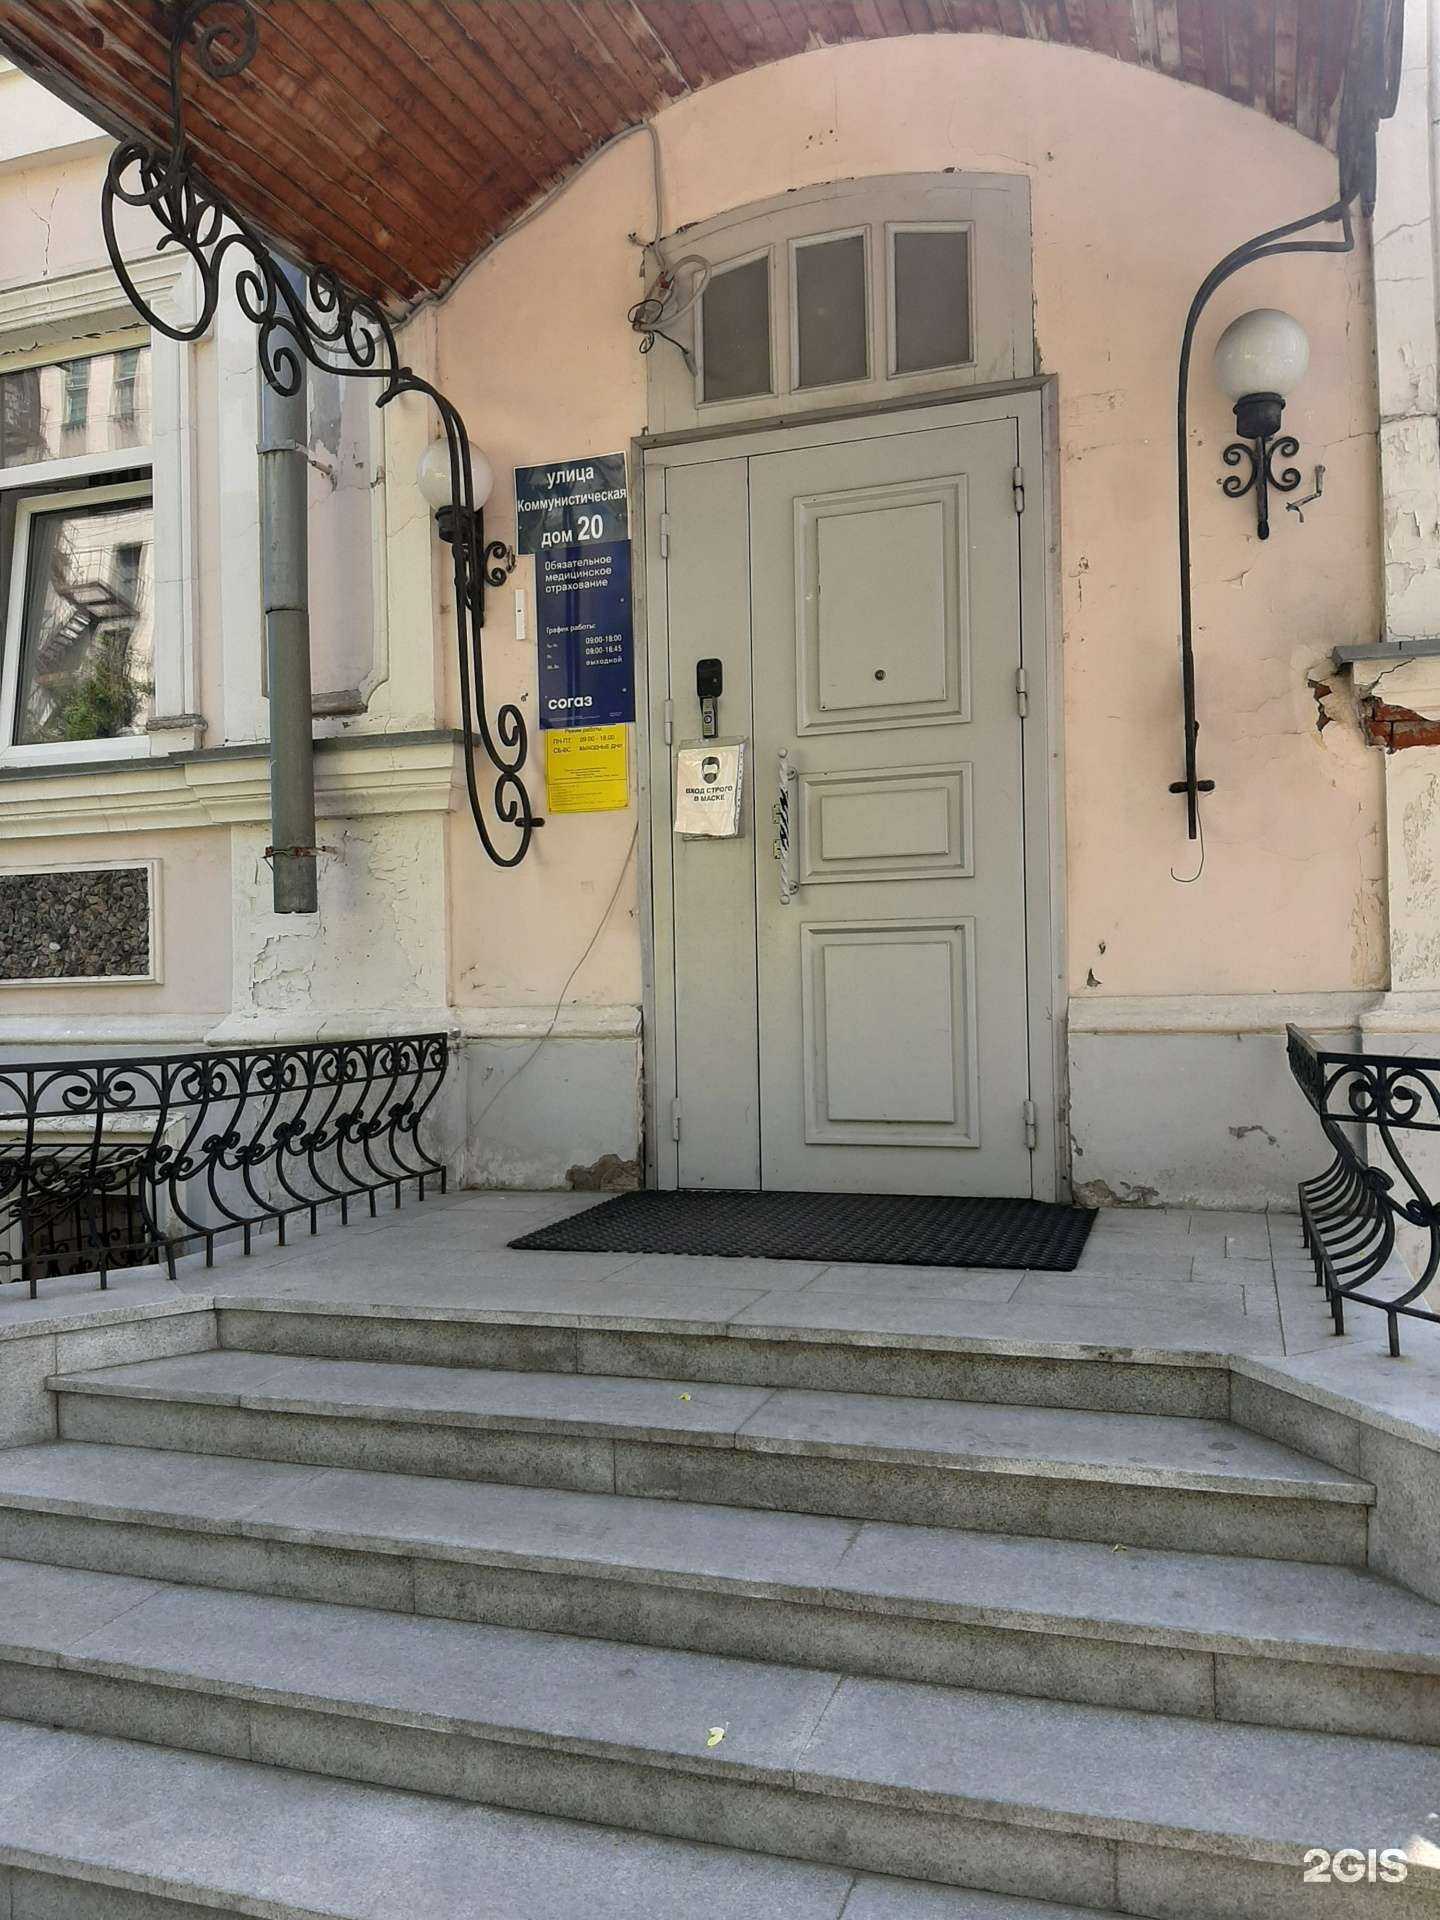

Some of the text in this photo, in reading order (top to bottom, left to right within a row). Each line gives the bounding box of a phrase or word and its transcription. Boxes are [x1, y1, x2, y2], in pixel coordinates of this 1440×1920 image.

[546, 466, 595, 490] улица
[517, 488, 628, 513] Коммунистическая
[541, 514, 604, 549] дом 20
[545, 555, 613, 572] Обязательное
[545, 567, 613, 582] медицинское
[545, 579, 609, 594] страхование
[685, 785, 733, 795] ВХОД СТРОГО
[701, 794, 725, 802] МАСКЕ
